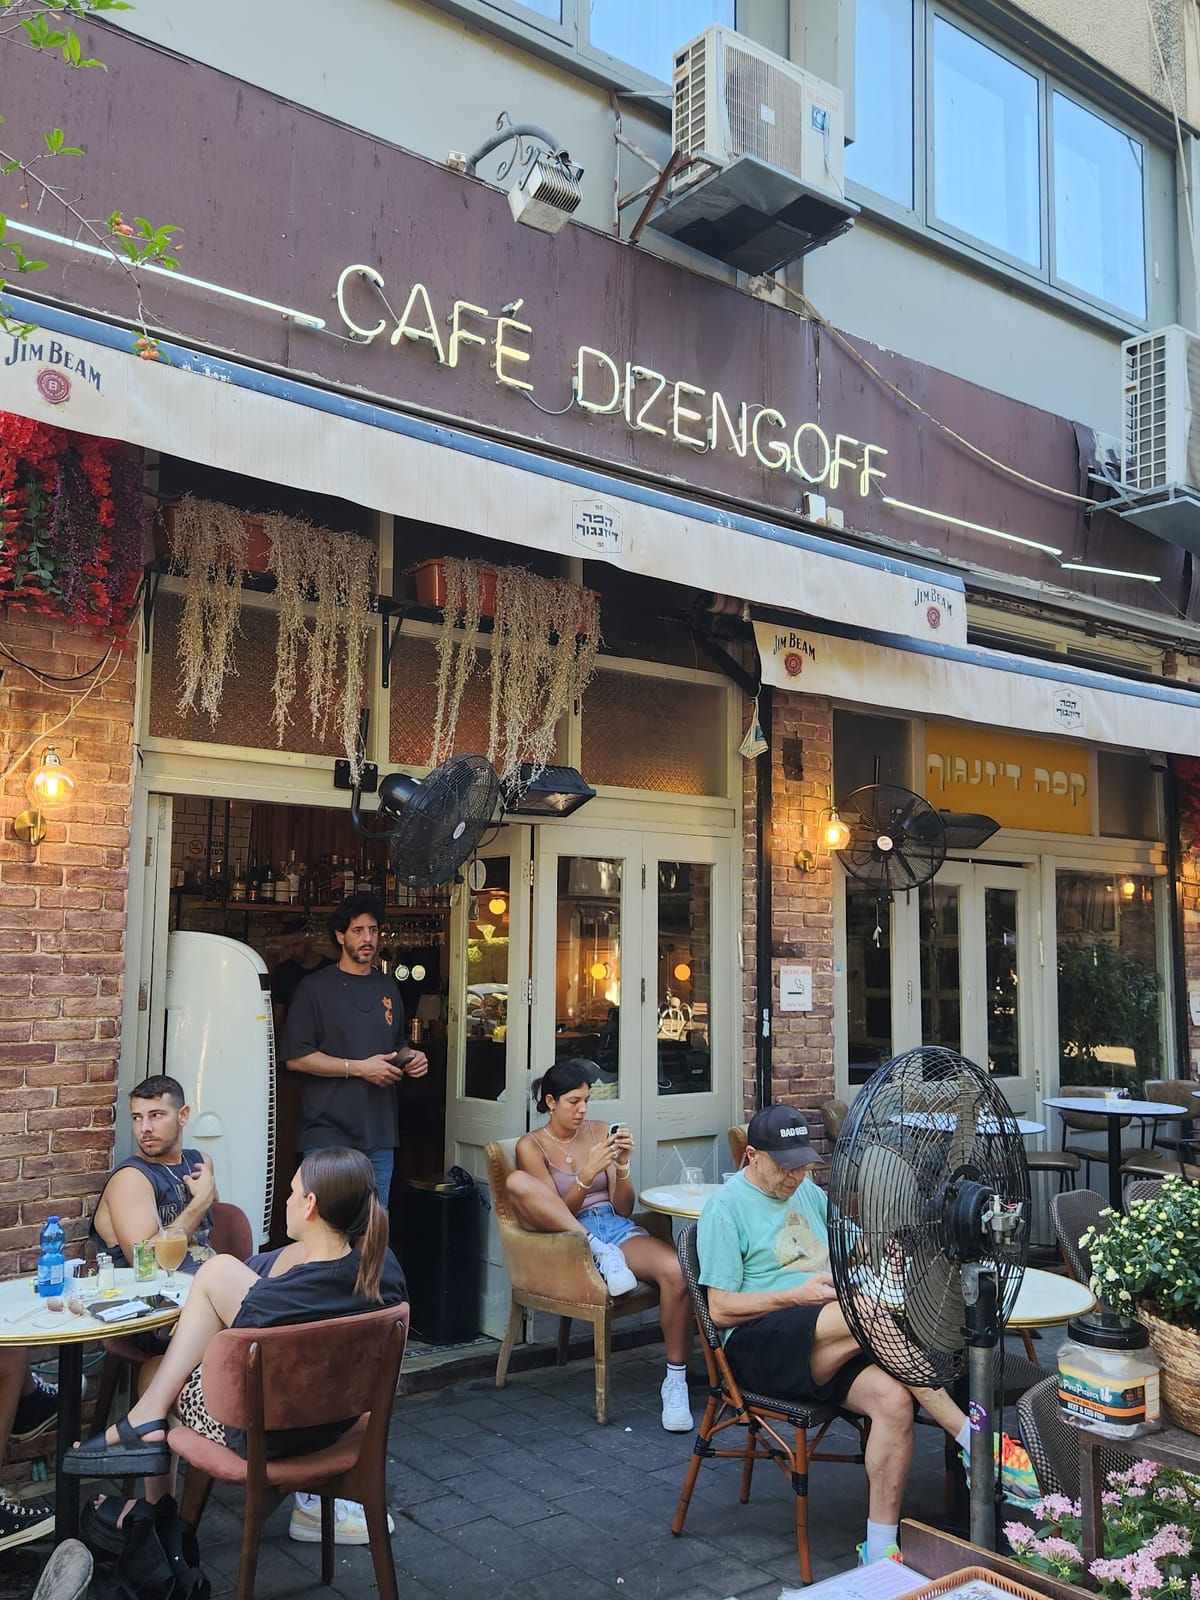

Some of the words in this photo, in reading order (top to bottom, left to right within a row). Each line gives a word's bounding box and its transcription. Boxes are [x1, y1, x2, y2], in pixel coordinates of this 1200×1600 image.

[5, 338, 44, 366] JIM
[48, 340, 101, 391] BEAM
[337, 264, 533, 391] CAFÉ
[577, 345, 889, 497] DIZENGOFF
[576, 523, 619, 542] דיזנגוף
[582, 512, 613, 528] קפה
[927, 753, 1022, 792] דיזנגוף
[1034, 767, 1087, 807] קפה
[780, 1128, 795, 1138] BAD
